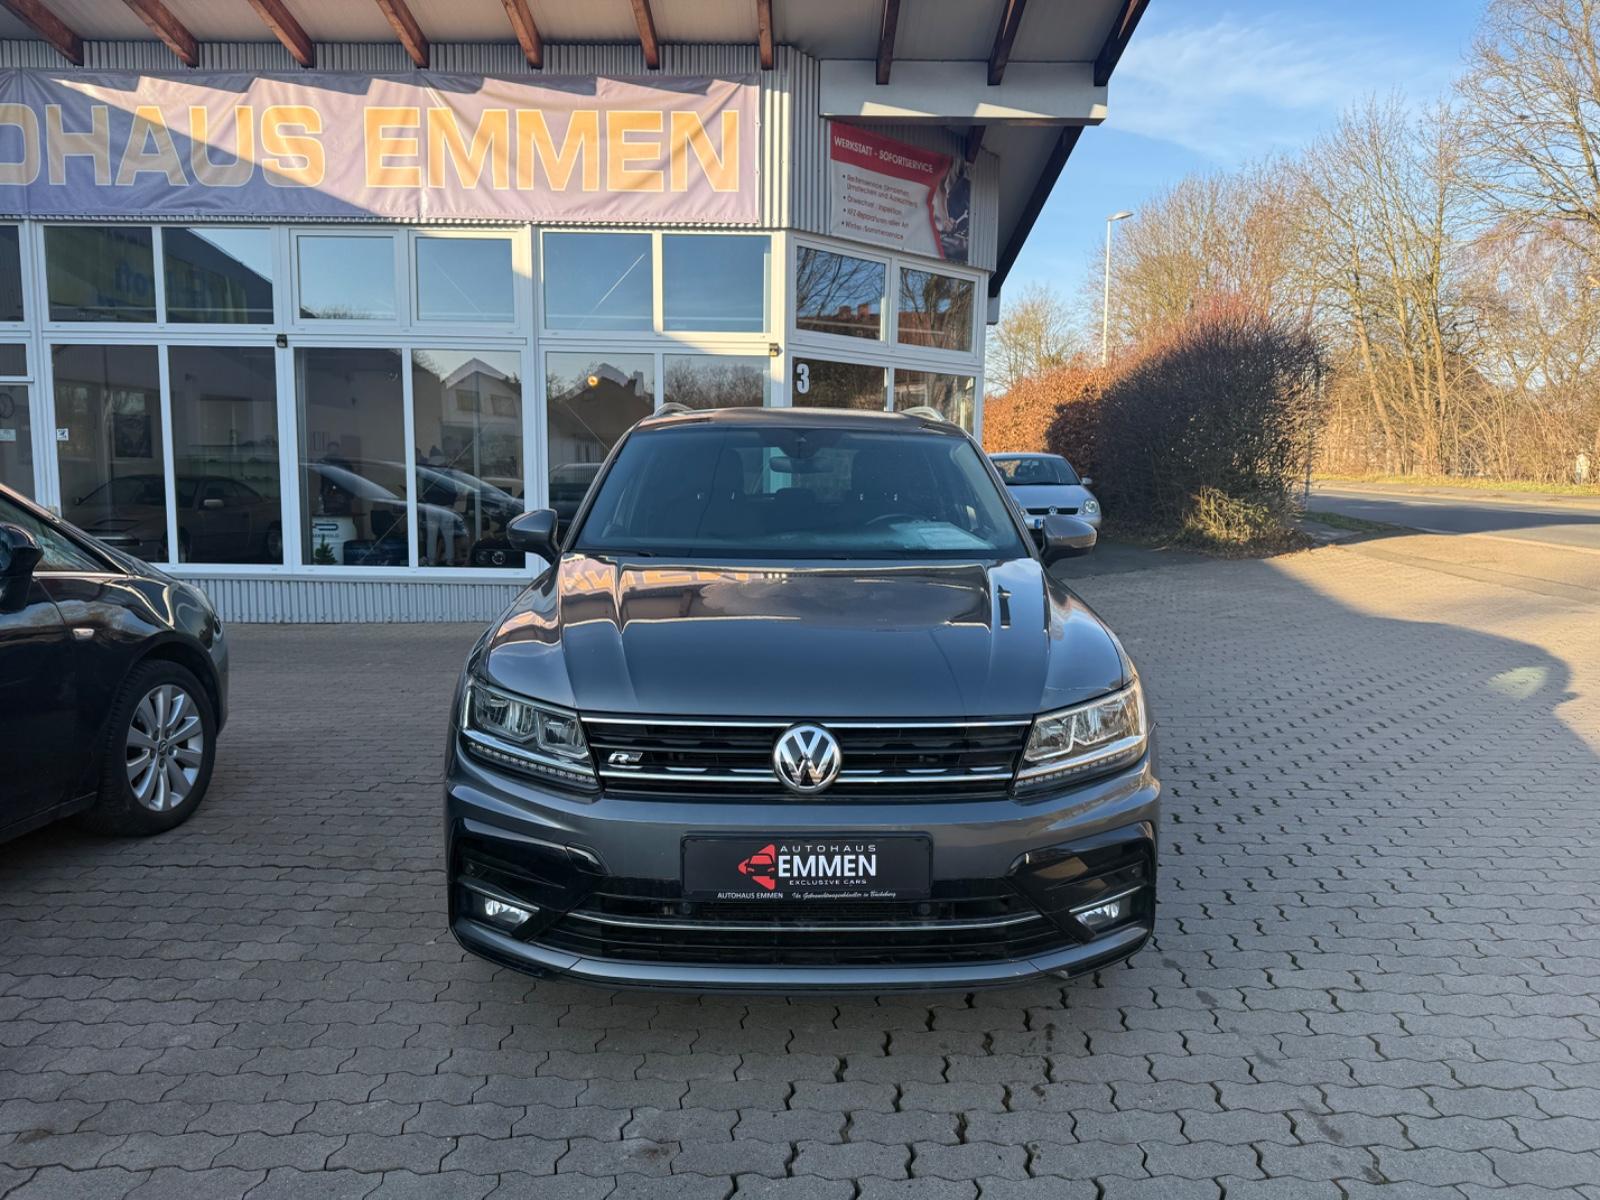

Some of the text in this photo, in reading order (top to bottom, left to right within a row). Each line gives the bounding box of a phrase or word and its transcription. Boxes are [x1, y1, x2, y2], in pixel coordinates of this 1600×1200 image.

[363, 105, 740, 193] EMMEN
[834, 135, 873, 157] WERKSTATT
[879, 149, 934, 174] SOFORTSERVICE
[796, 363, 810, 394] 3
[775, 727, 840, 791] VW
[778, 854, 877, 877] EMMEN
[780, 844, 877, 853] AUTOHAUS
